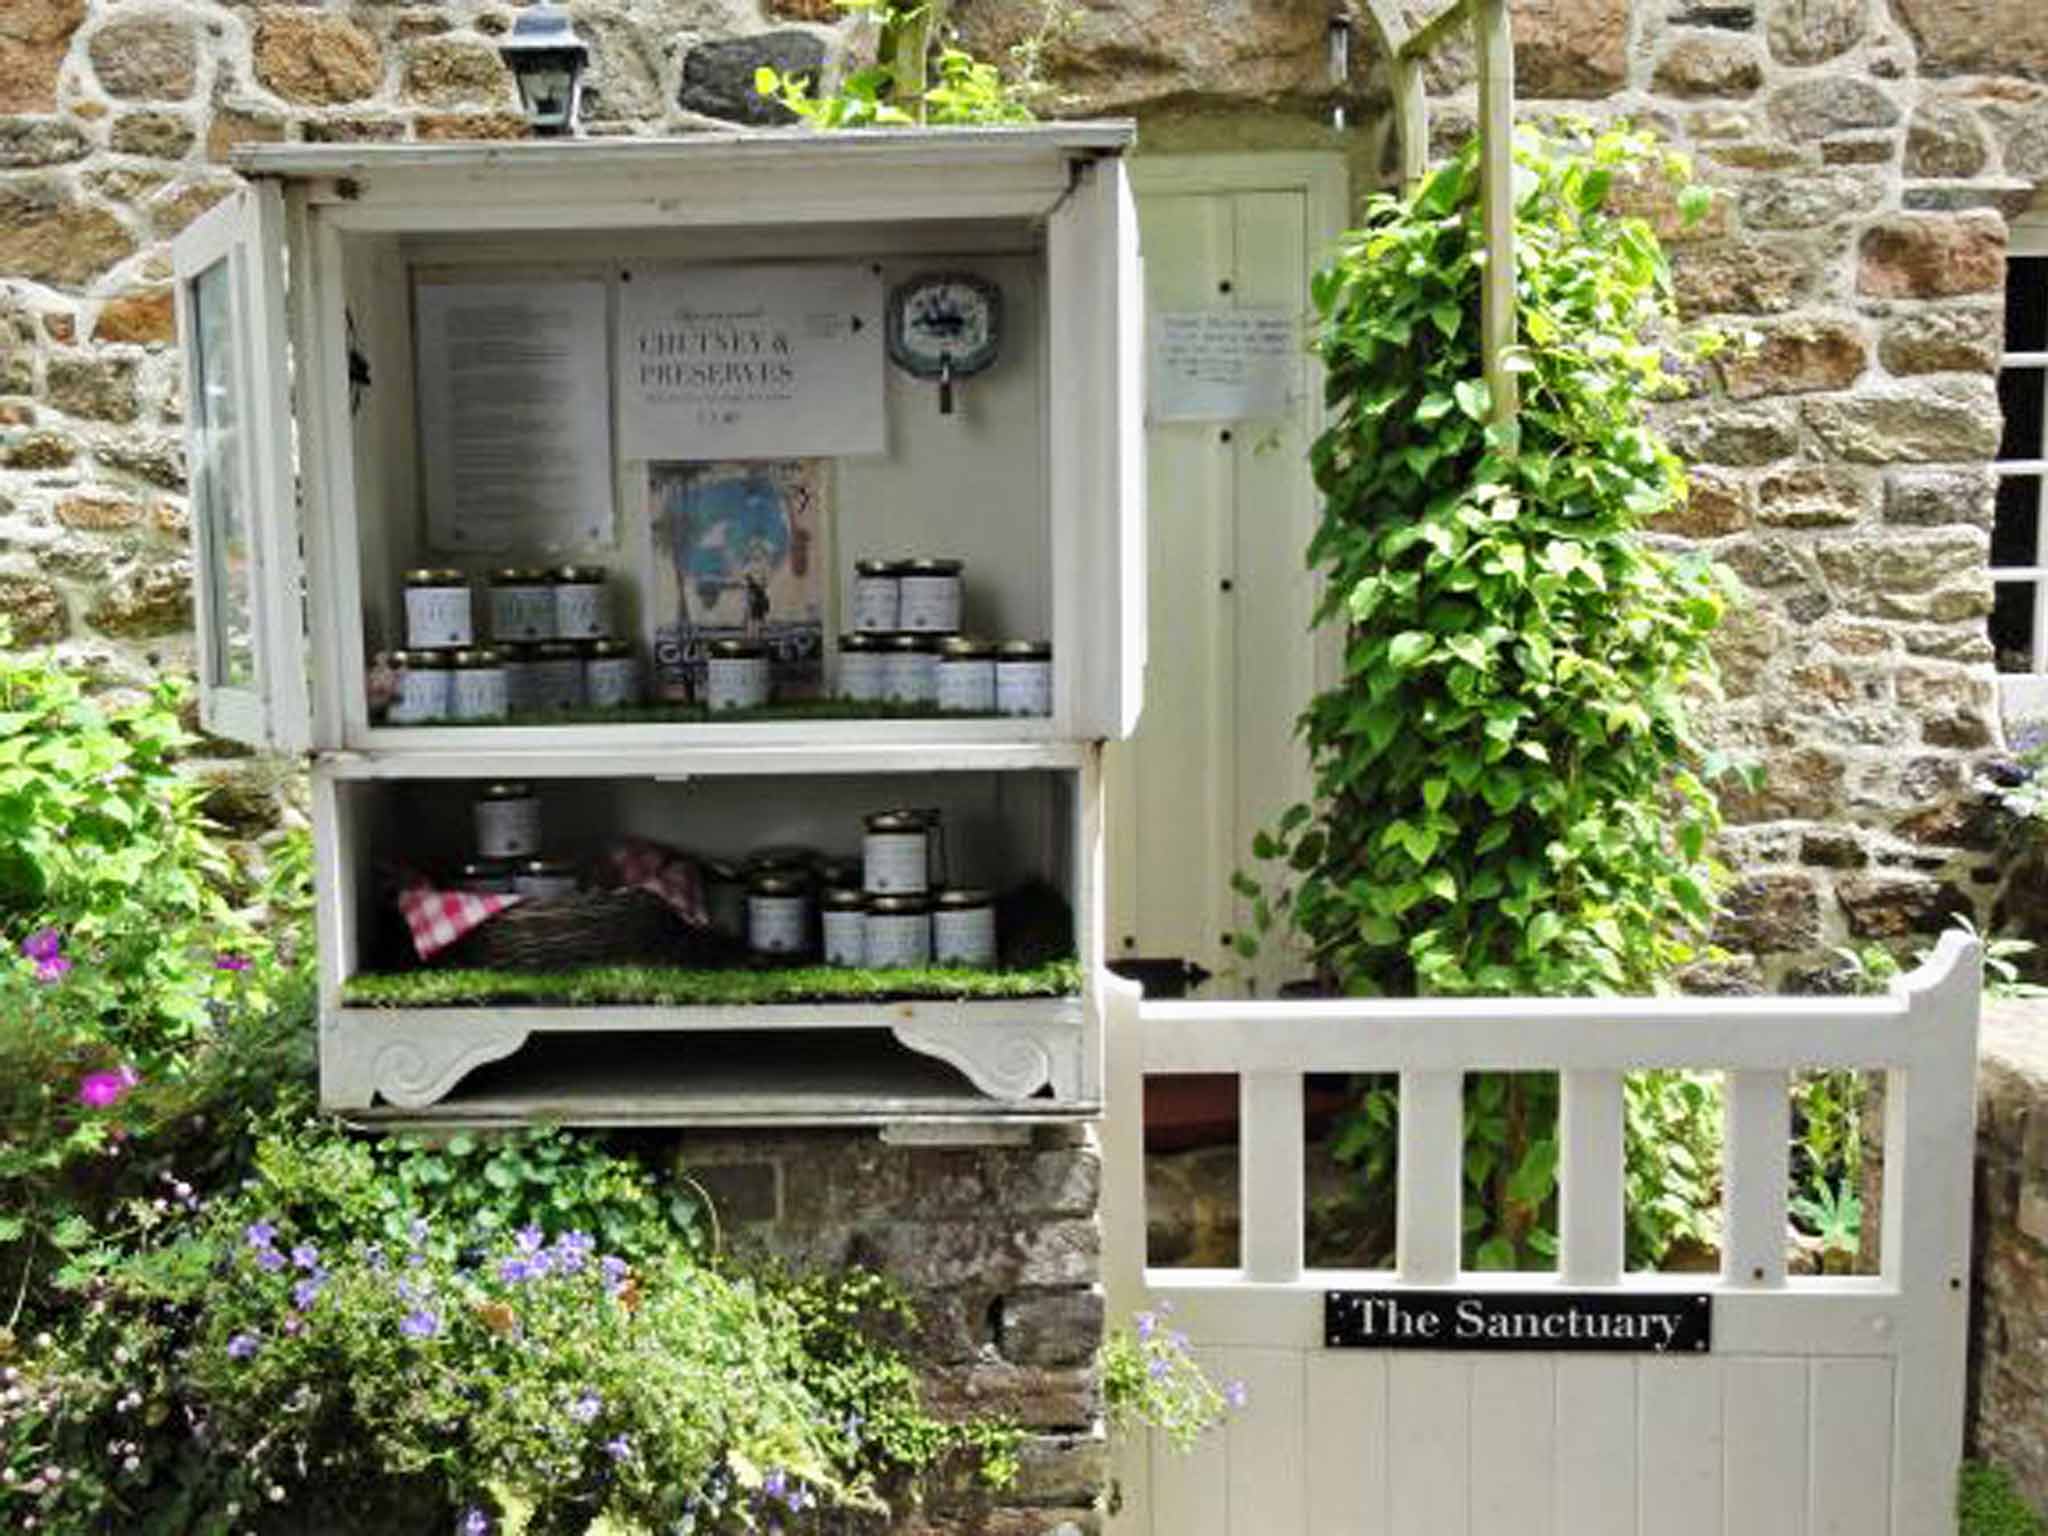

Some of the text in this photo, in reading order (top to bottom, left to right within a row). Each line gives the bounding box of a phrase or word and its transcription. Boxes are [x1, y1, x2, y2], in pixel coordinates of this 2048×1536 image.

[639, 362, 793, 386] PRESERVES
[1352, 1299, 1682, 1345] The Sanctuary
